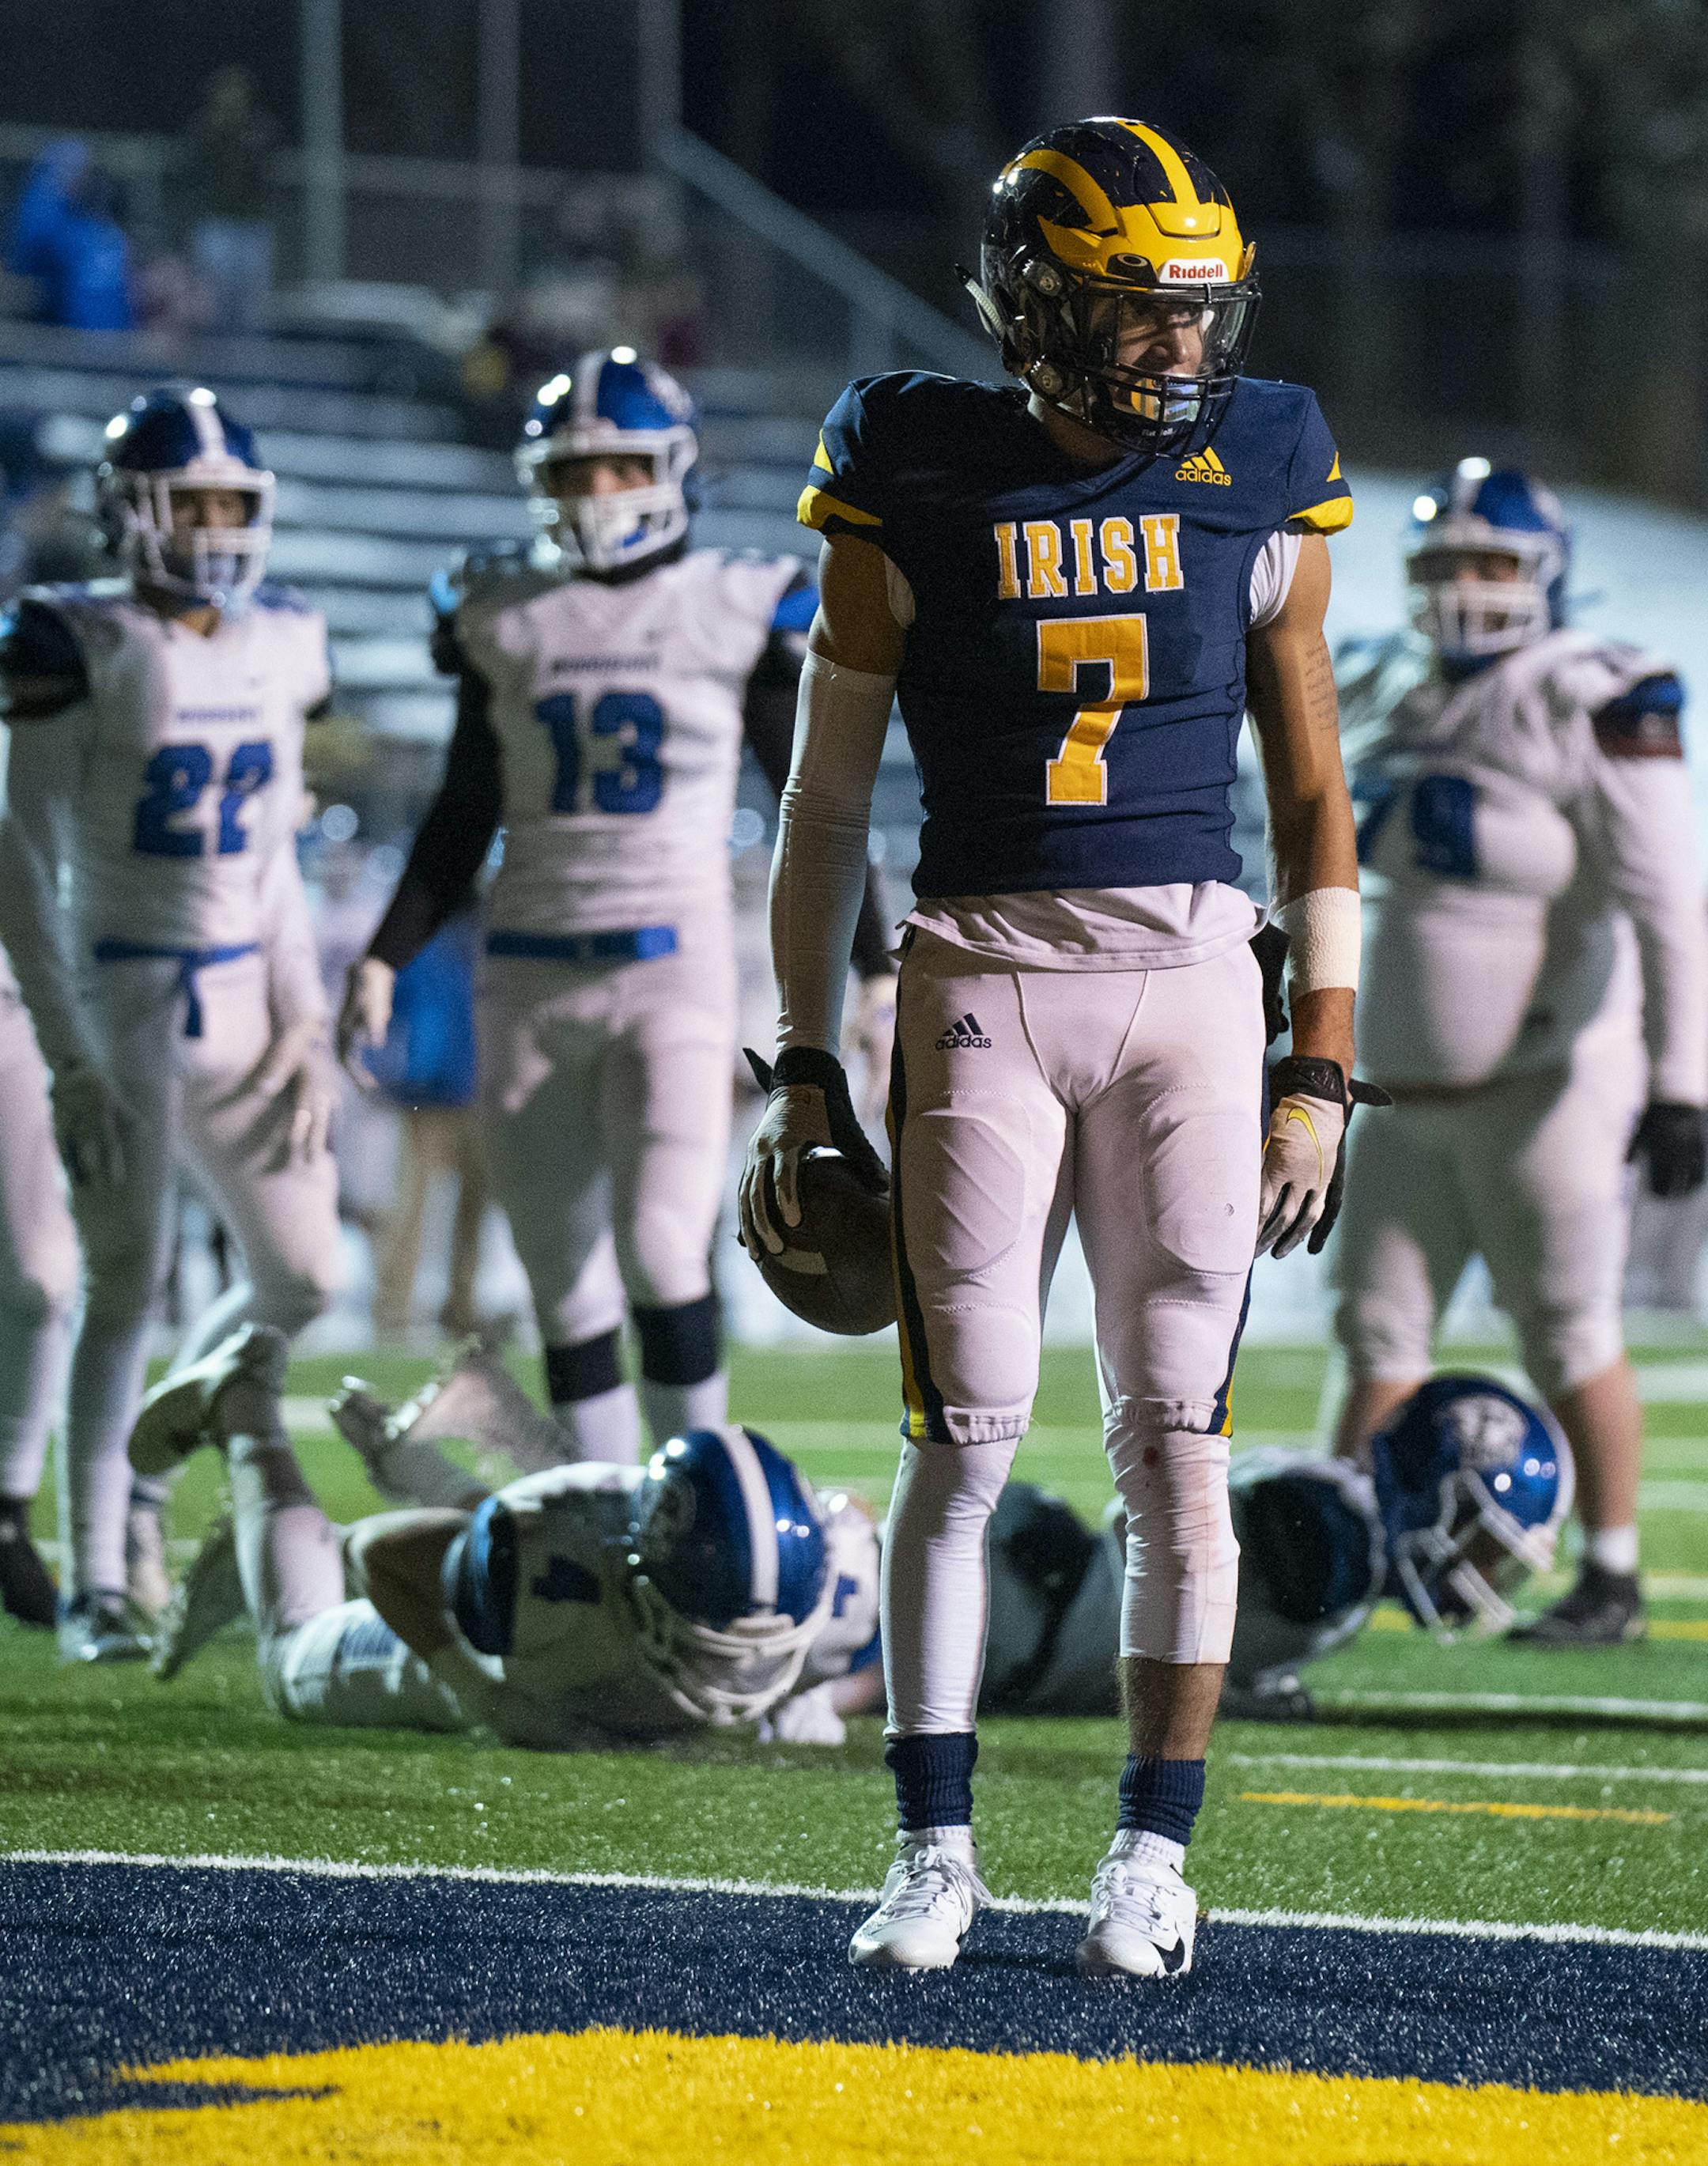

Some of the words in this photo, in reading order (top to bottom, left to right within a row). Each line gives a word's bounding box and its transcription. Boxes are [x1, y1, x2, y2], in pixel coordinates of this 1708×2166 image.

[1169, 263, 1223, 279] Riddell
[1175, 468, 1232, 486] adidas
[993, 513, 1185, 601] IRISH
[534, 691, 664, 815] 13
[1036, 612, 1151, 806] 7
[134, 741, 274, 856] 22
[935, 1034, 992, 1051] adidas
